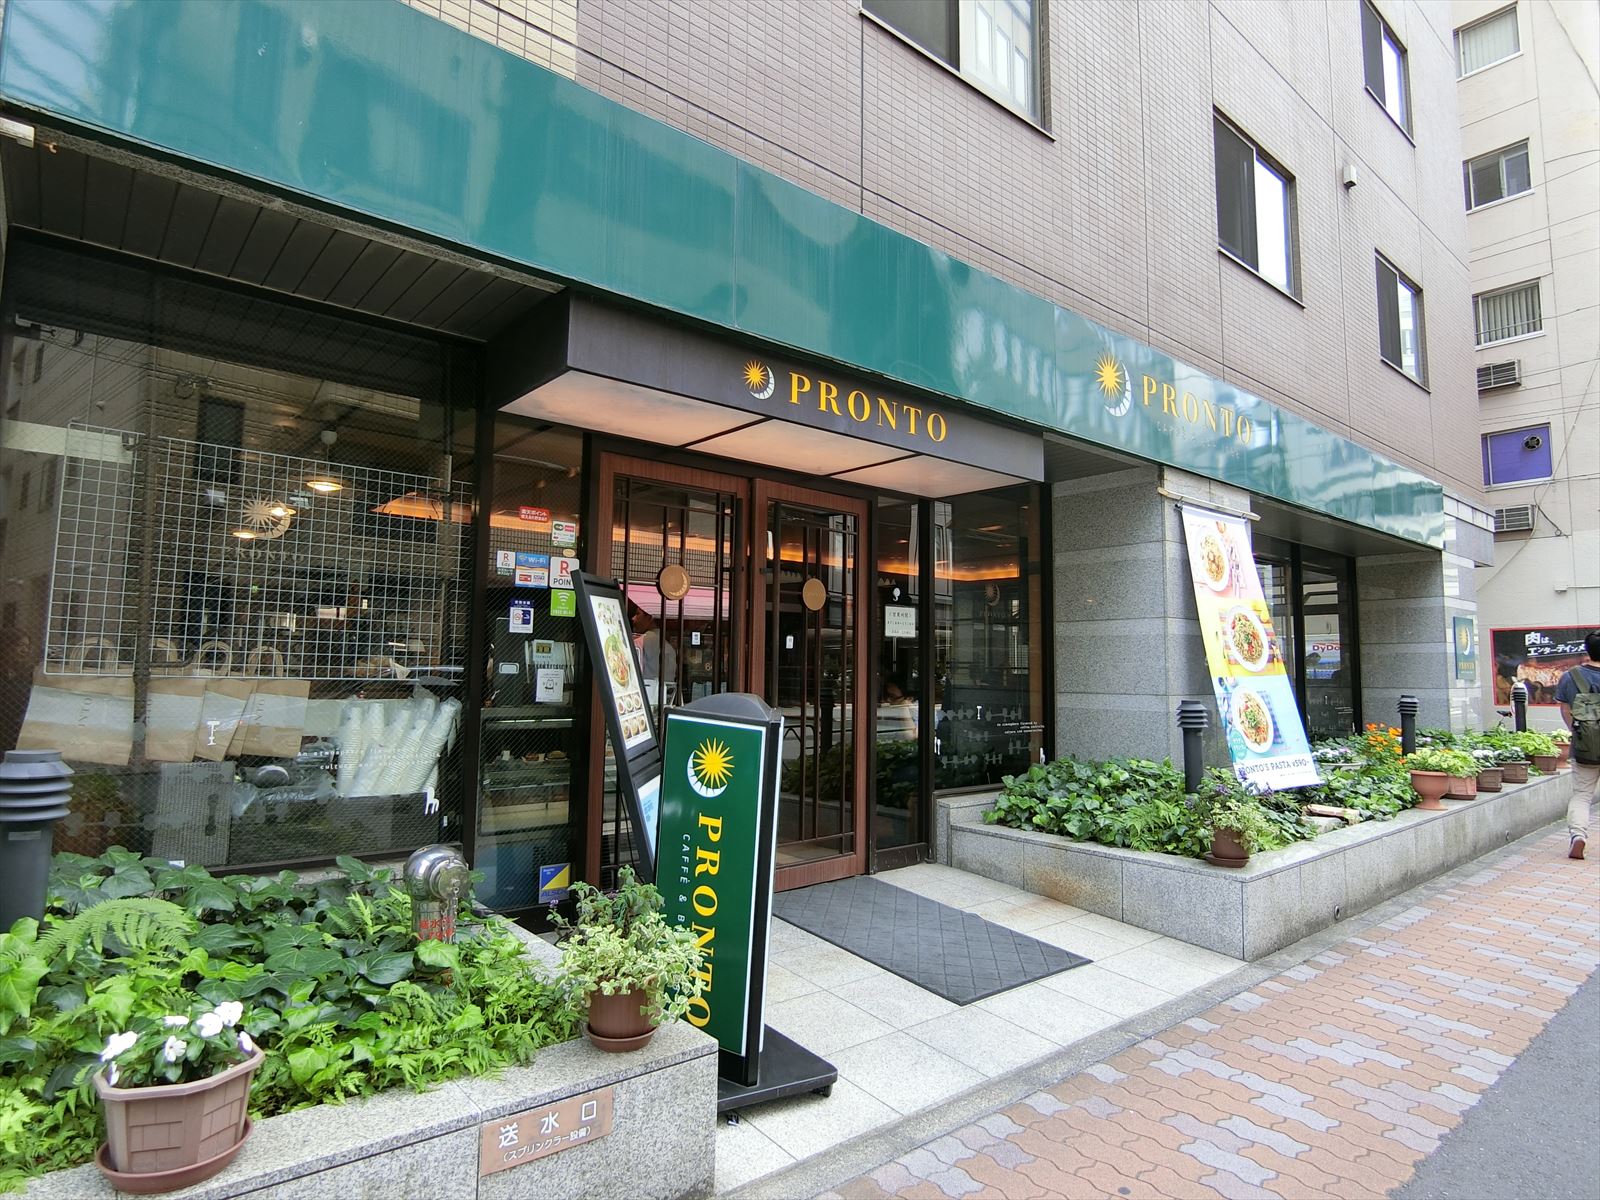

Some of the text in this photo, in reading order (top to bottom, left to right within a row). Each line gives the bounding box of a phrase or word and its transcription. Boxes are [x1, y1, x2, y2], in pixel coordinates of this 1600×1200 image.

[789, 371, 948, 443] PRONTO
[1142, 375, 1252, 445] PRONTO
[528, 556, 546, 564] Wi-Fi
[553, 577, 572, 586] POIN
[1240, 763, 1270, 775] ONTO'S
[1270, 761, 1291, 771] PASTA
[678, 894, 688, 903] &
[685, 812, 723, 1028] PRONTO
[498, 1100, 597, 1149] 送水口
